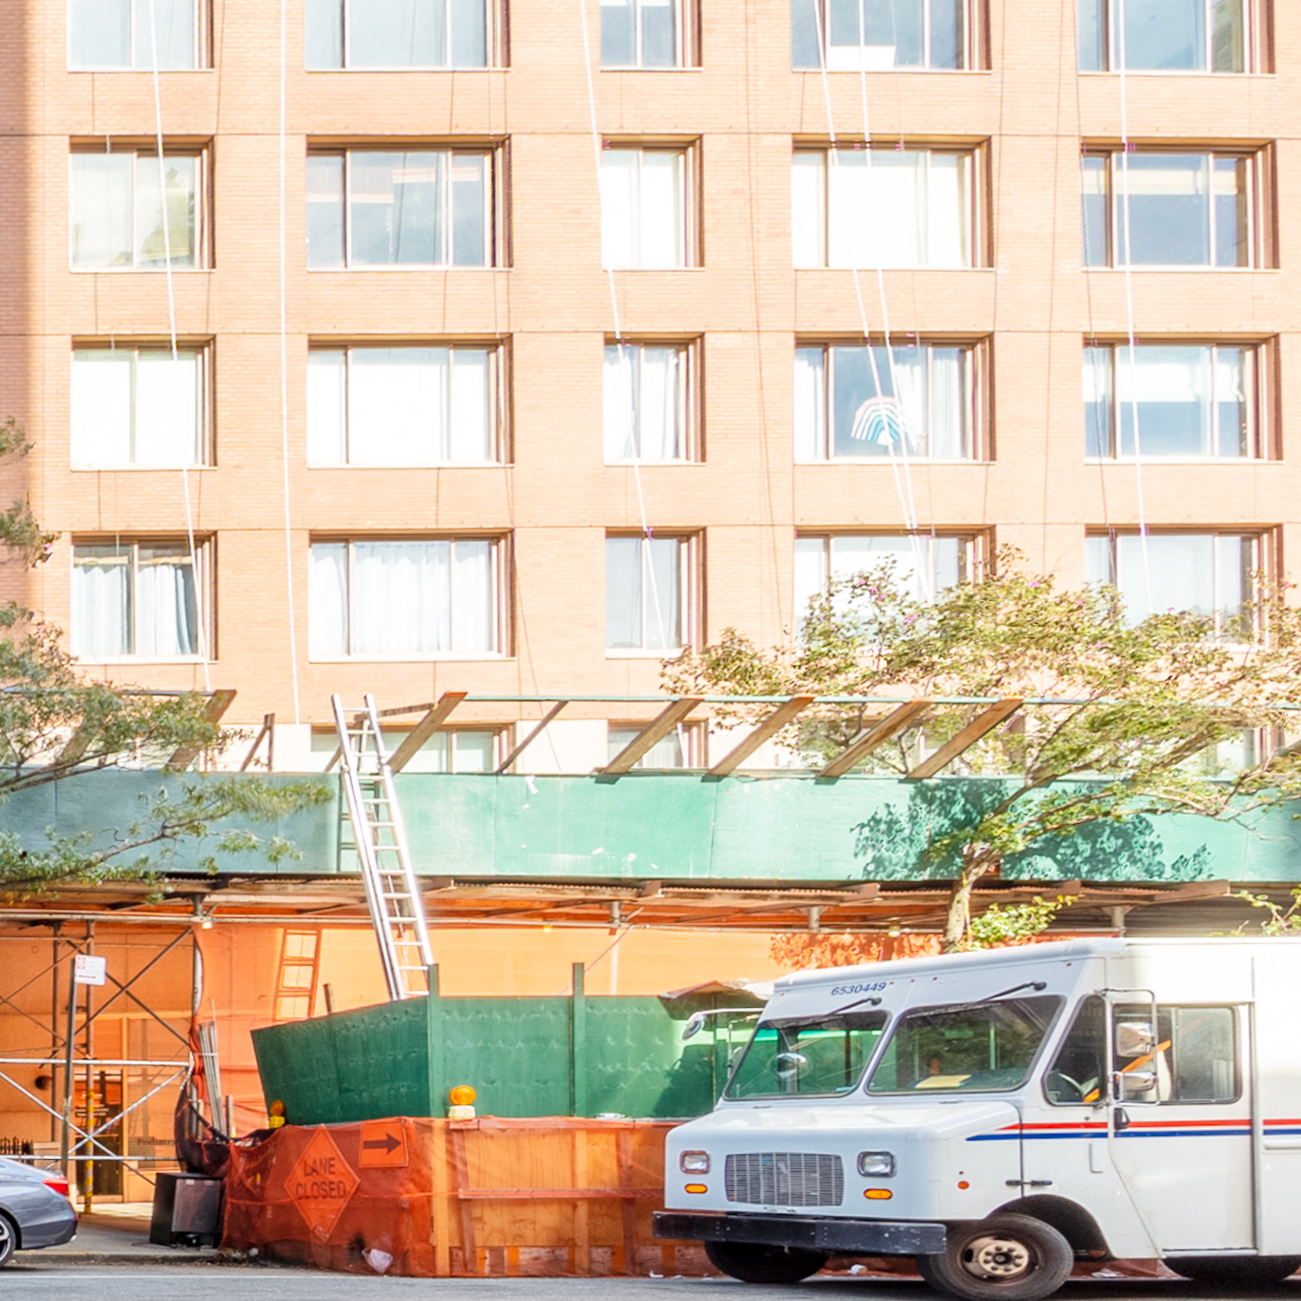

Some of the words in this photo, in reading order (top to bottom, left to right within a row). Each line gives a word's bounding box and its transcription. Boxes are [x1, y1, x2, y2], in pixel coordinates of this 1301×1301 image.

[831, 982, 887, 996] 6530449
[304, 1157, 336, 1177] LANE
[295, 1180, 346, 1200] CLOSED
